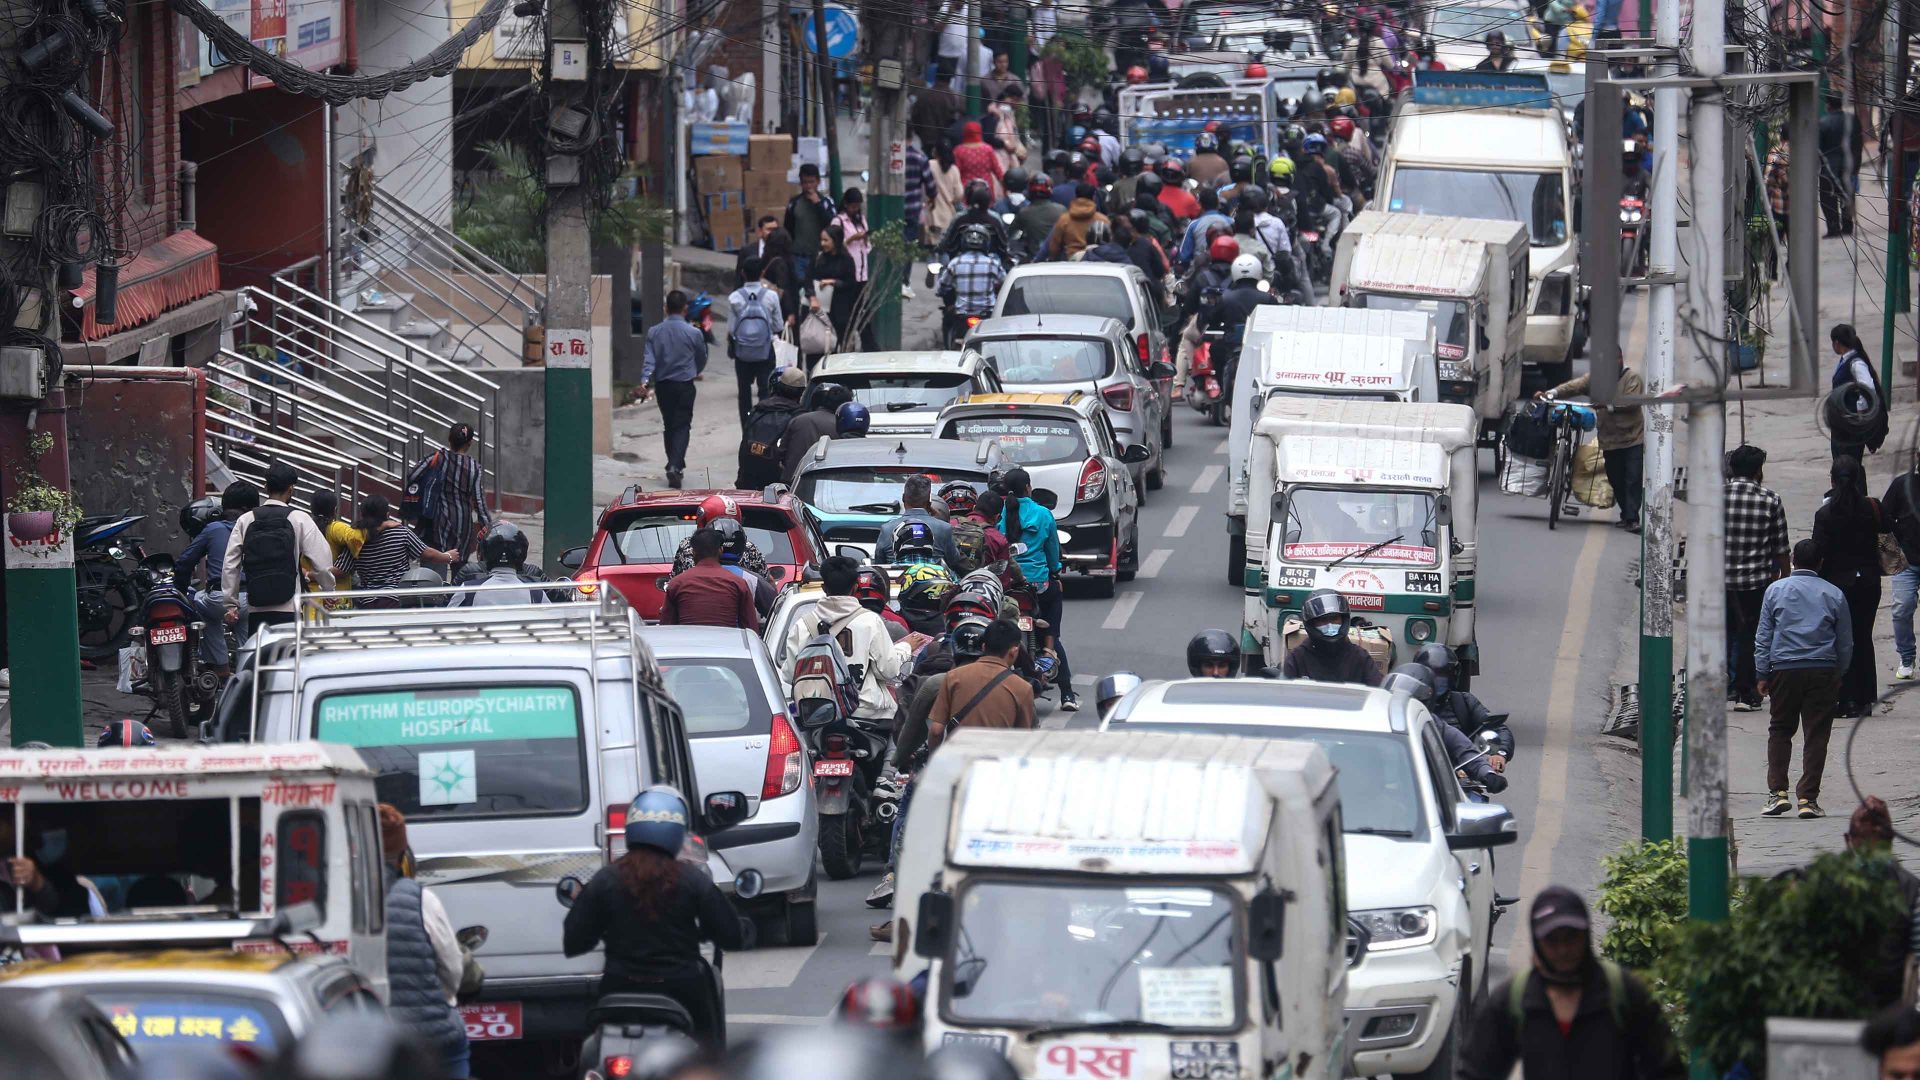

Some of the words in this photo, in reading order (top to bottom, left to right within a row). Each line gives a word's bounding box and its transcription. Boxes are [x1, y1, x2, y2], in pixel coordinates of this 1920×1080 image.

[1280, 576, 1314, 587] ४१४१
[1408, 573, 1420, 581] BA
[1428, 573, 1439, 582] HA
[1406, 583, 1439, 592] 4141
[325, 703, 399, 722] RHYTHM
[403, 695, 568, 718] NEUROPSYCHIATRY
[401, 717, 493, 738] HOSPITAL
